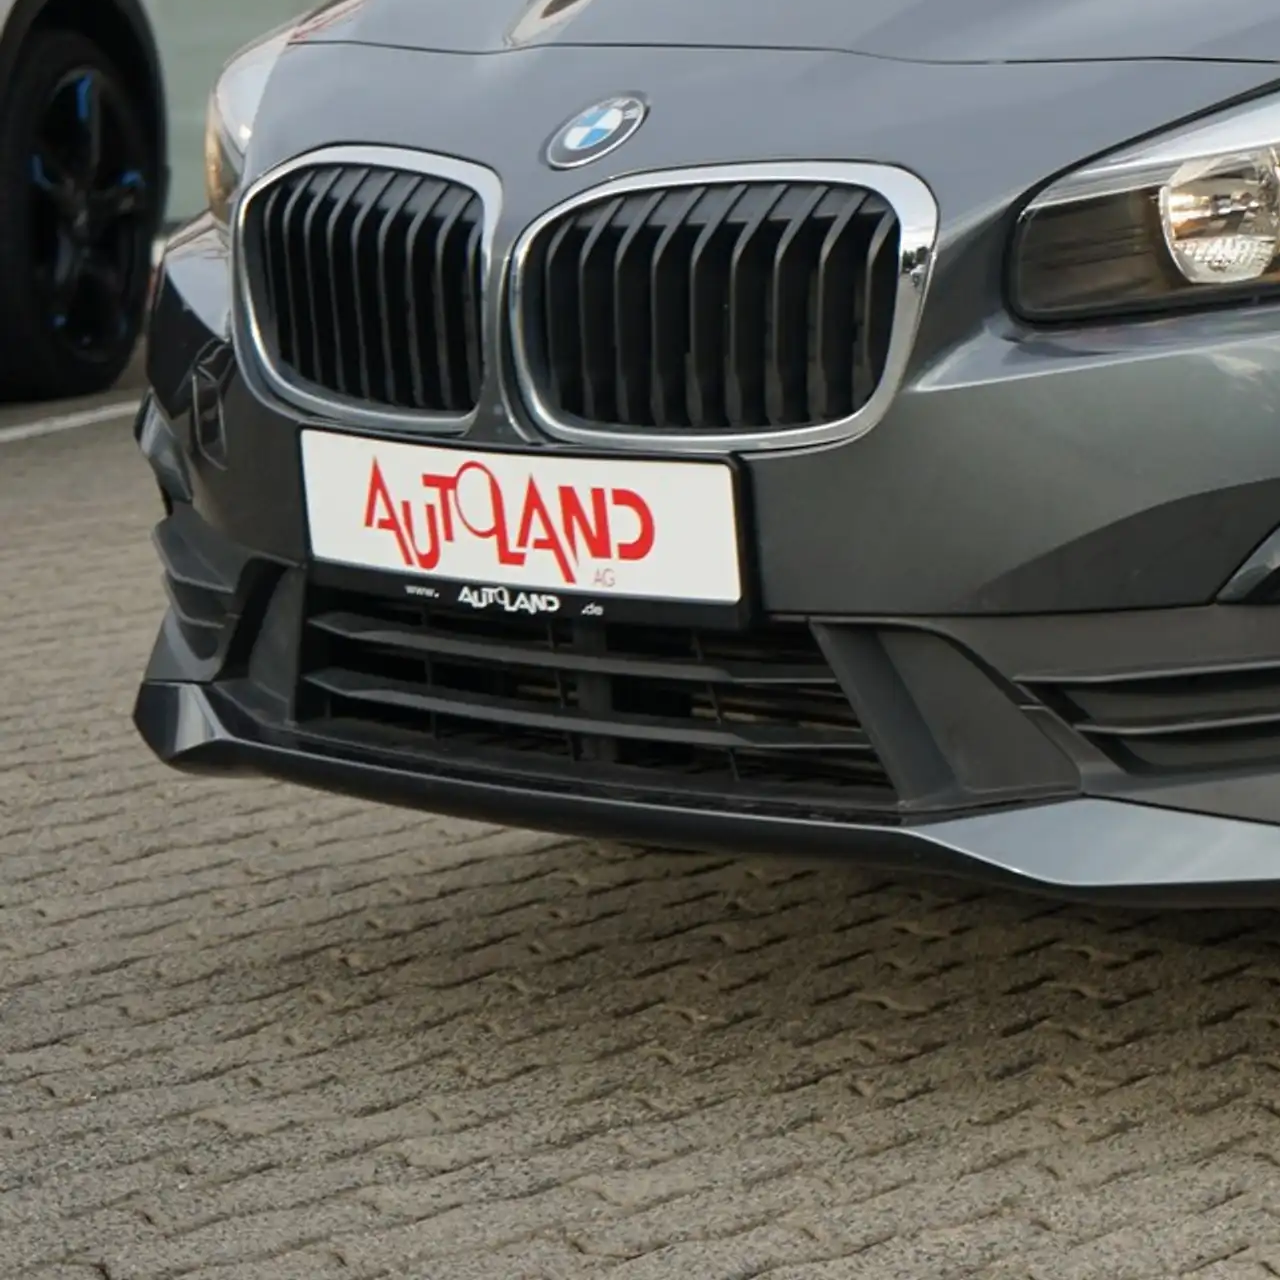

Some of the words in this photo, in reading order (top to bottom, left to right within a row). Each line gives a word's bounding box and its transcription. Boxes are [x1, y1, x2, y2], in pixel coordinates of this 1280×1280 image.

[364, 456, 656, 584] AUTOLAND
[593, 569, 615, 587] AG
[404, 584, 440, 599] www.
[457, 586, 560, 614] AUTOLAND
[580, 602, 604, 616] .de
